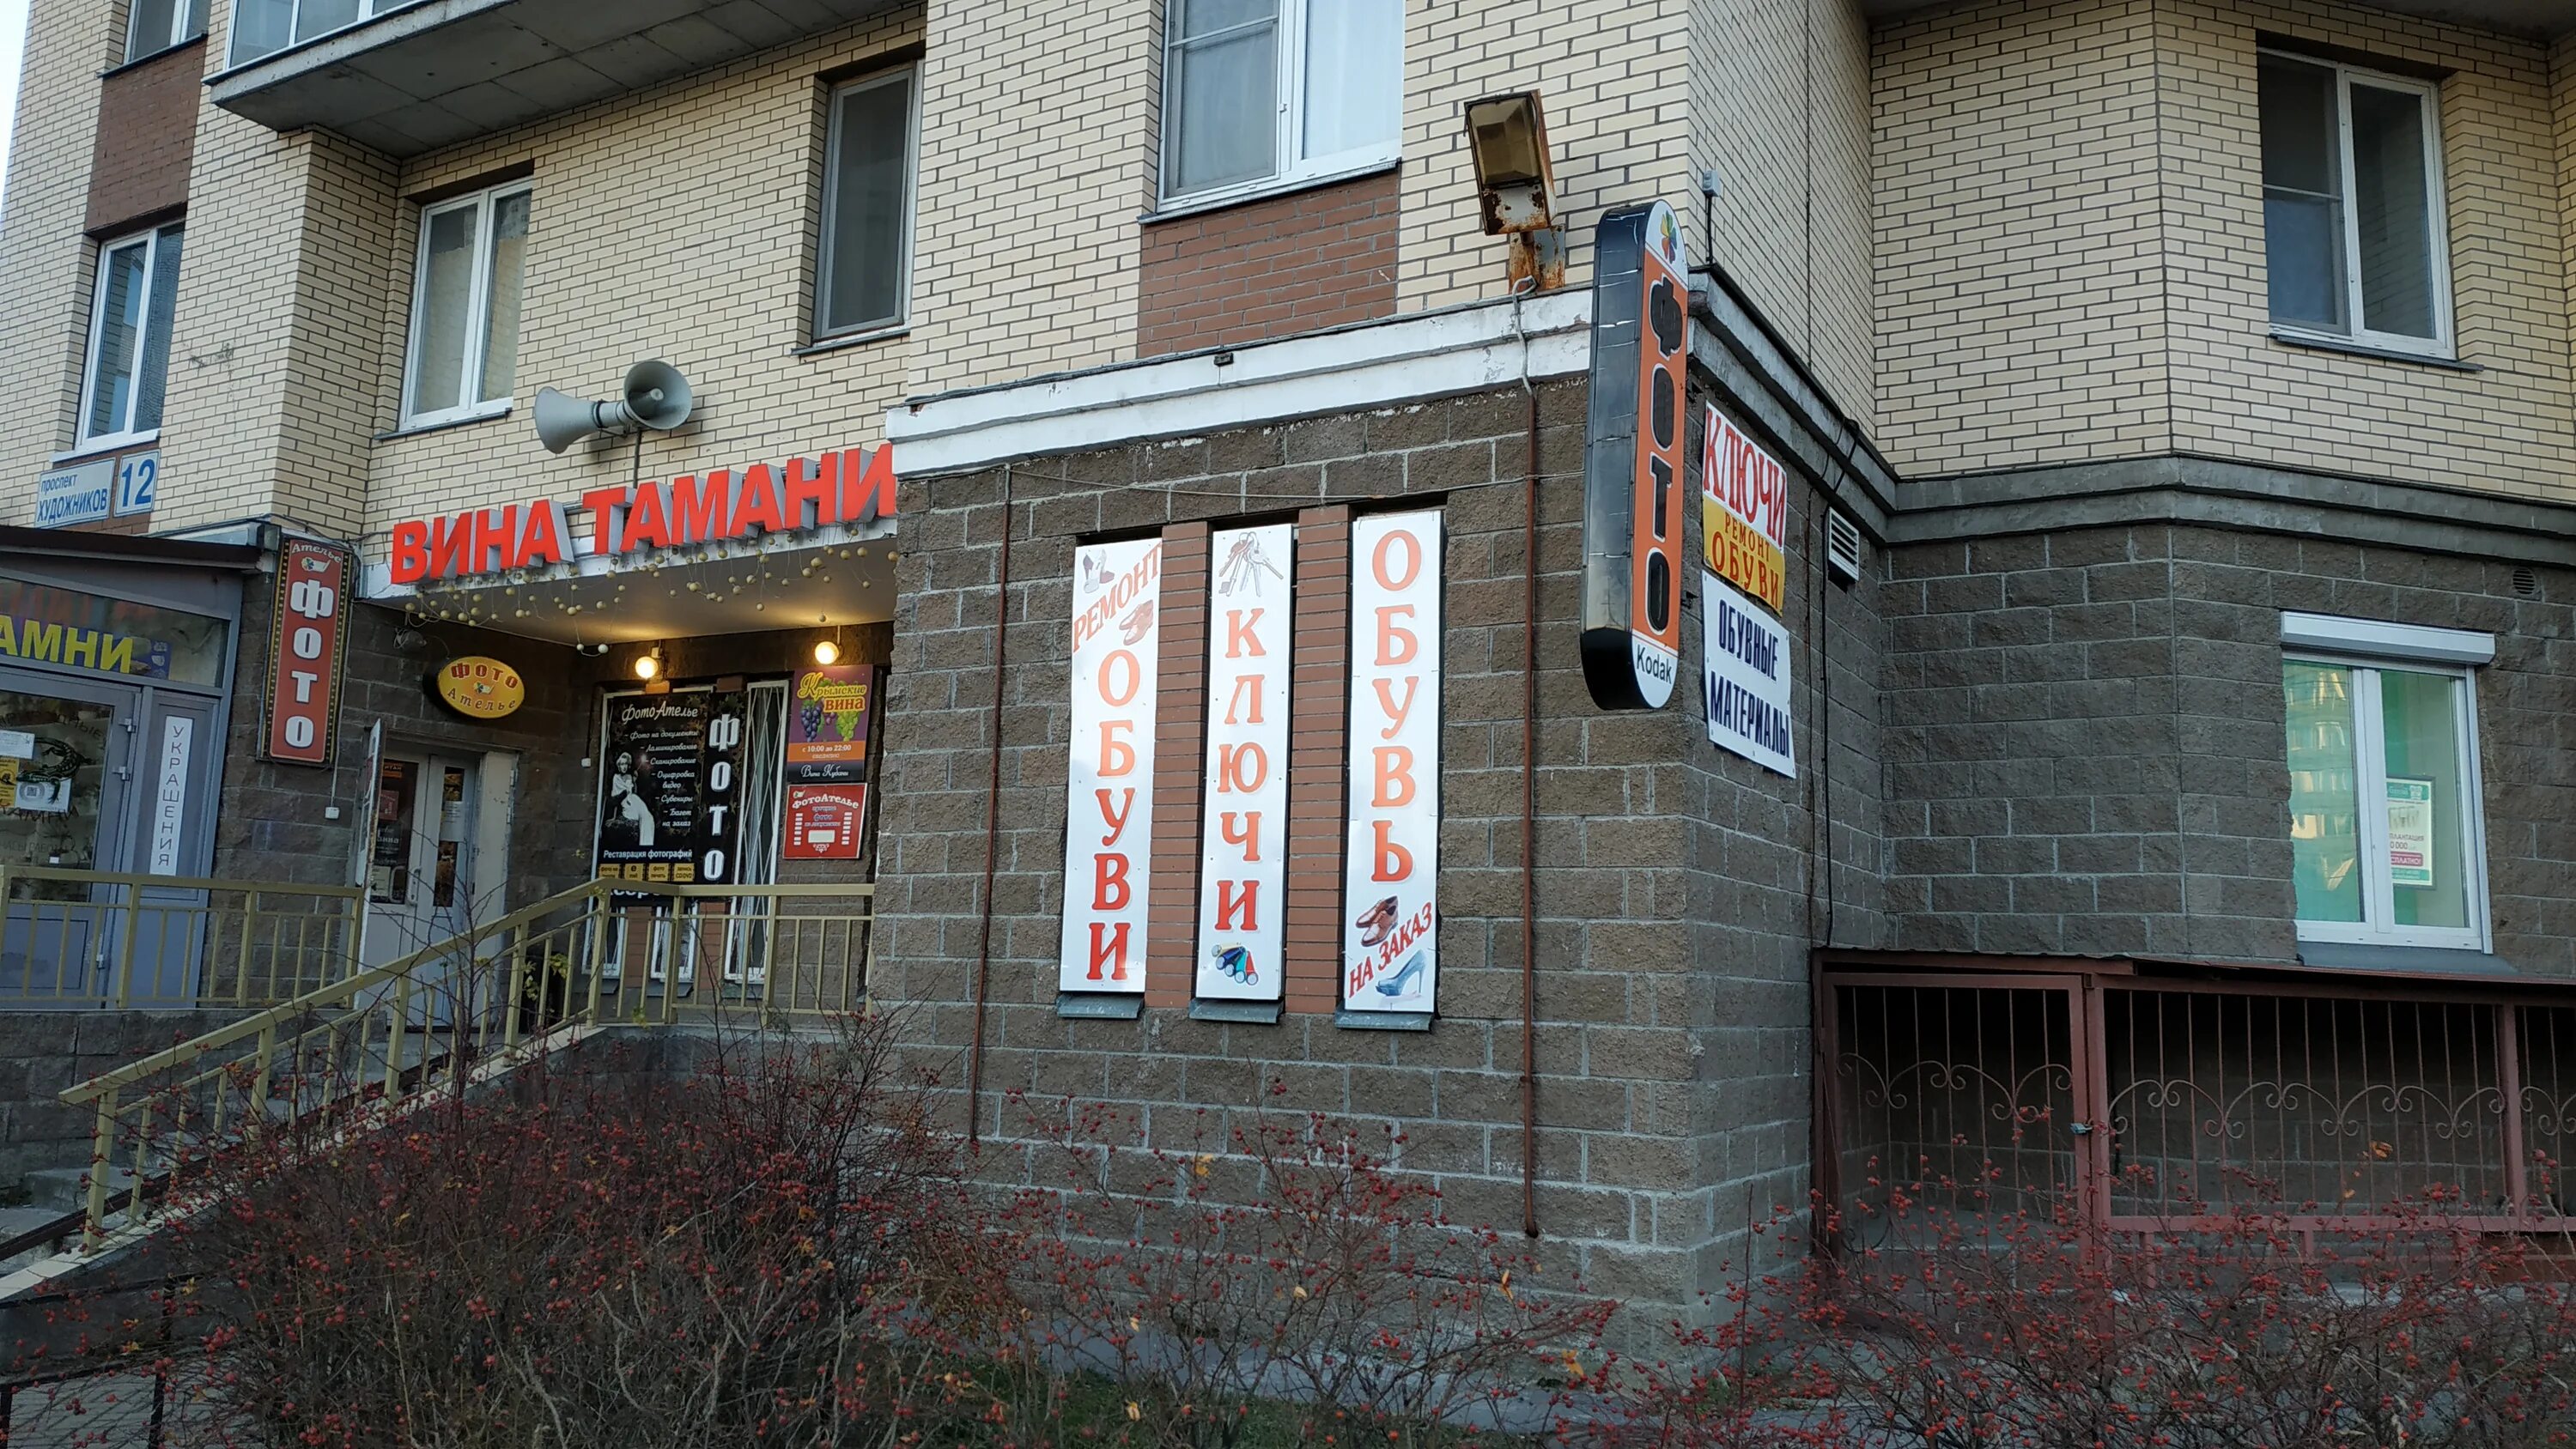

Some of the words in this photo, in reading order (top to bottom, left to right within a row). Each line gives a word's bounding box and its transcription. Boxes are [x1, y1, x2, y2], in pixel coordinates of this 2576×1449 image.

[40, 474, 78, 495] проспект
[122, 458, 155, 507] 12
[1645, 275, 1684, 636] ФОТО
[1703, 405, 1788, 549] КЛЮЧИ
[37, 488, 108, 524] ХУДОЖНИКОВ
[391, 499, 568, 585] ВИНА
[582, 443, 896, 555] ТАМАНИ
[1724, 510, 1771, 563] РЕМОНТ
[292, 543, 342, 563] Ателье
[1711, 532, 1781, 609] ОБУВИ
[1072, 541, 1163, 653] РЕМОНТ
[284, 579, 335, 749] ФОТО
[451, 663, 519, 688] ФОТО
[1636, 642, 1673, 686] Kodak
[1718, 600, 1779, 682] ОБУВНЫЕ
[447, 688, 515, 711] Ателье
[621, 700, 699, 725] ФотоАтелье
[797, 672, 866, 701] Крымские
[824, 696, 865, 712] вина
[1371, 529, 1422, 883] ОБУВЬ
[1710, 671, 1790, 759] МАТЕРИАЛЫ
[158, 725, 185, 866] УКРАШЕНИЯ
[703, 713, 741, 881] ФОТО
[1215, 608, 1268, 931] КЛЮЧИ
[1087, 648, 1140, 980] ОБУВИ
[647, 849, 693, 860] фотографий
[1349, 961, 1375, 998] НА
[1377, 901, 1433, 971] ЗАКАЗ
